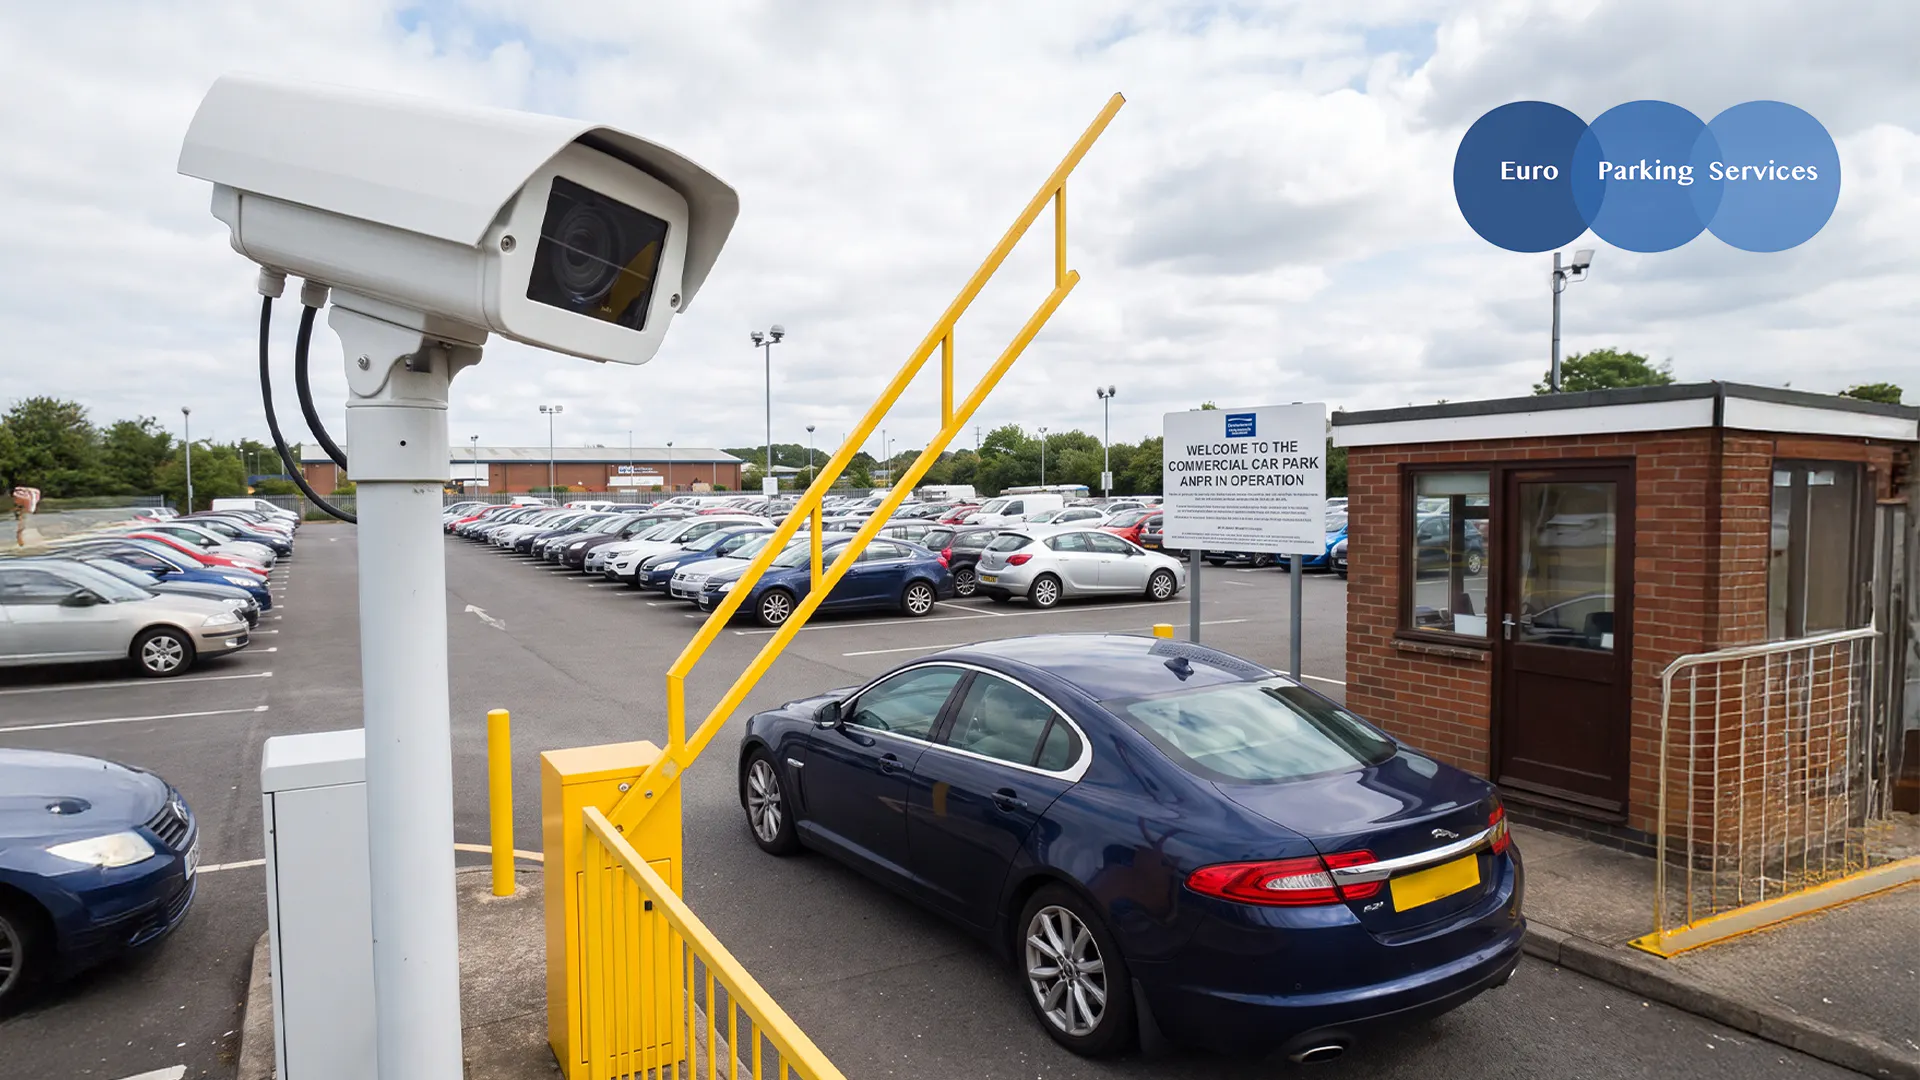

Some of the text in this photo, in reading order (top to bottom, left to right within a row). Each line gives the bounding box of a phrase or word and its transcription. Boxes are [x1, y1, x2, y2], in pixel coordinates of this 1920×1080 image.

[1186, 440, 1298, 456] WELCOME TO THE
[1168, 456, 1319, 472] COMMERCIAL CAR PARK
[1180, 474, 1304, 487] ANPR IN OPERATION
